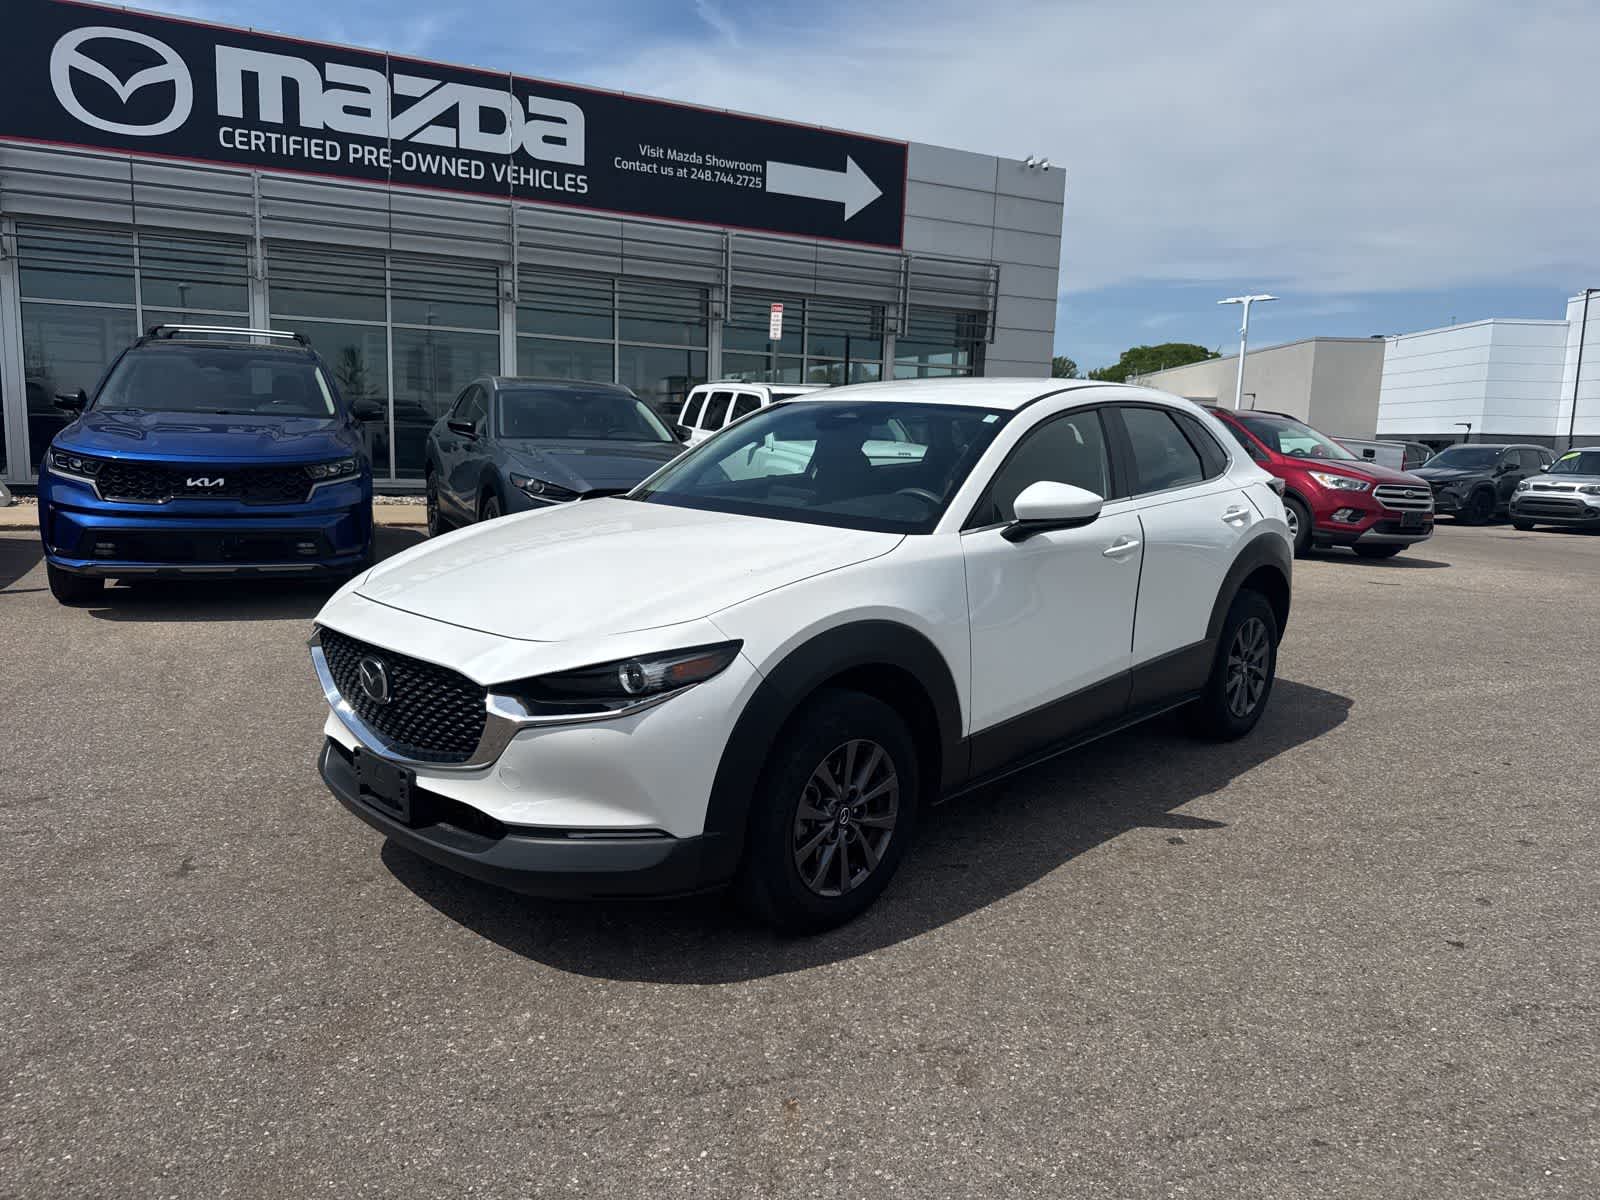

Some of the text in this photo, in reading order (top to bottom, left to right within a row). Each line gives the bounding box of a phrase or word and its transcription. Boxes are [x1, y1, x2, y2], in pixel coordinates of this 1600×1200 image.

[218, 126, 589, 194] CERTIFIED PRE-OWNED VEHICLES
[614, 156, 763, 189] Contact us at 248.744.2725
[638, 143, 763, 174] Visit Mazda Showroom
[186, 477, 225, 487] KIA
